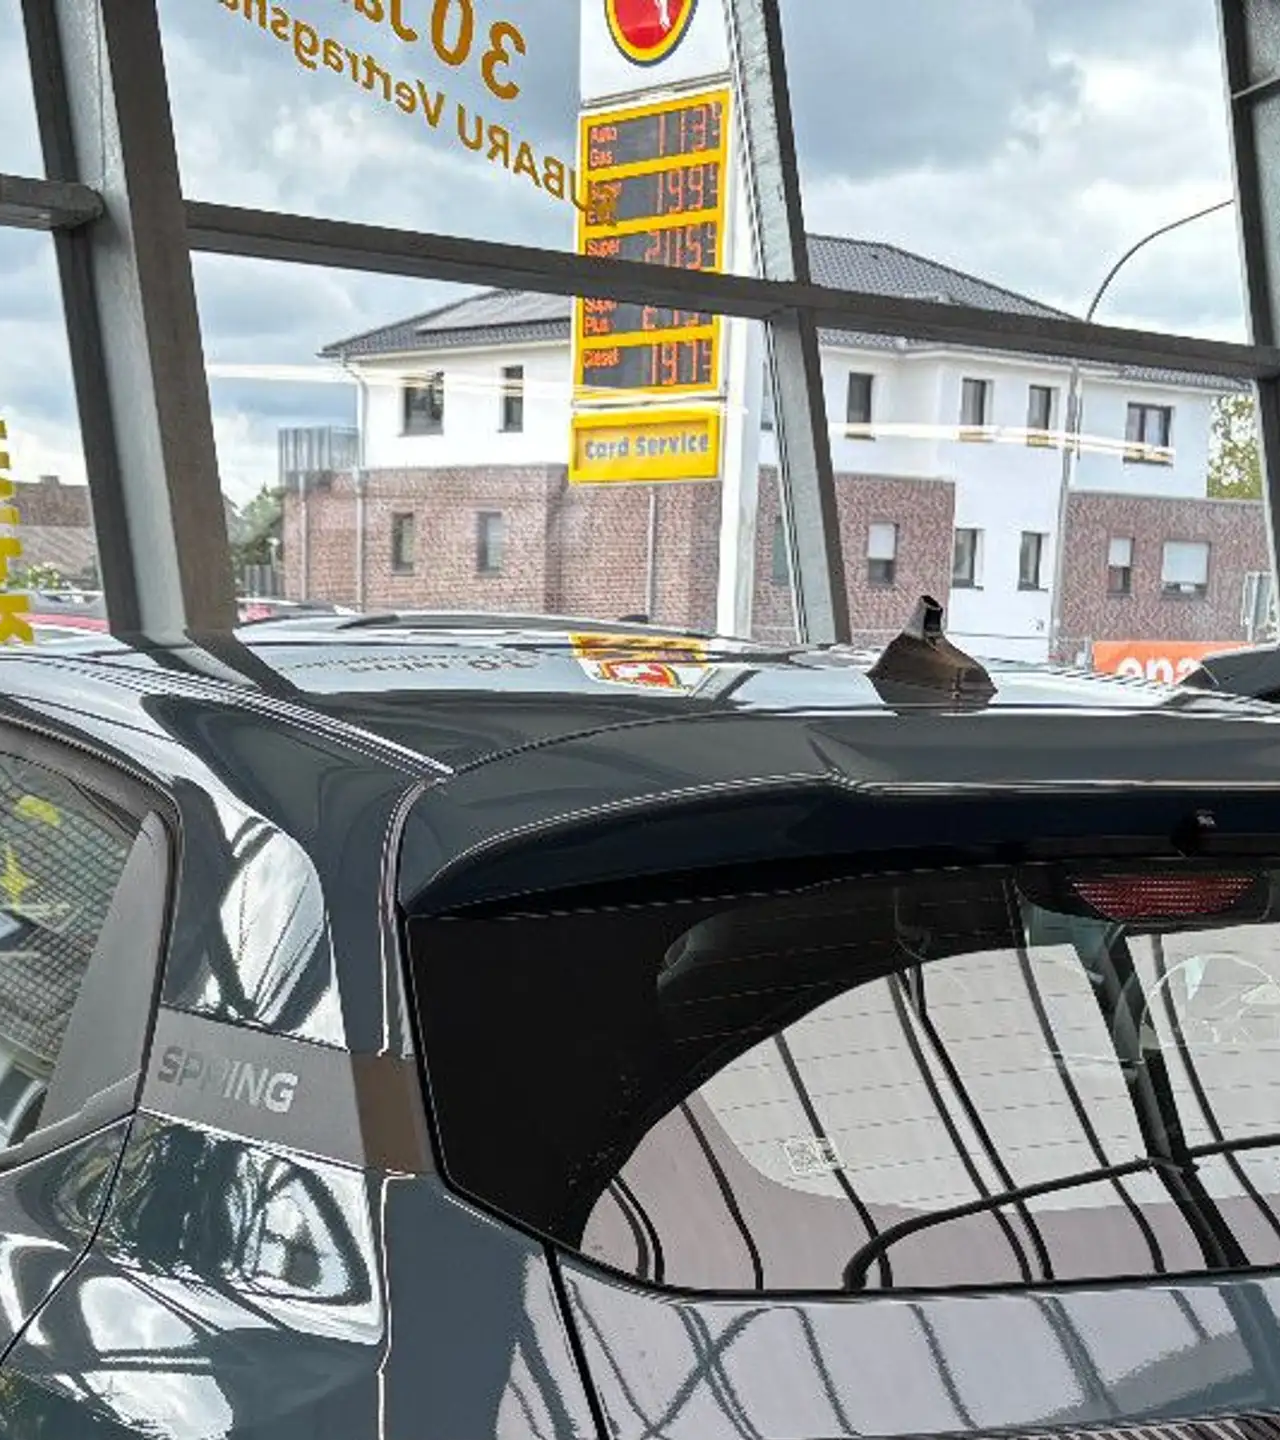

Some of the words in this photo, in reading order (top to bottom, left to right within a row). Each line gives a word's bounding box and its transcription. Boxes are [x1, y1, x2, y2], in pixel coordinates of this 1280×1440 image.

[585, 437, 630, 462] Card
[635, 430, 710, 457] Service
[157, 1045, 299, 1114] SPRING
